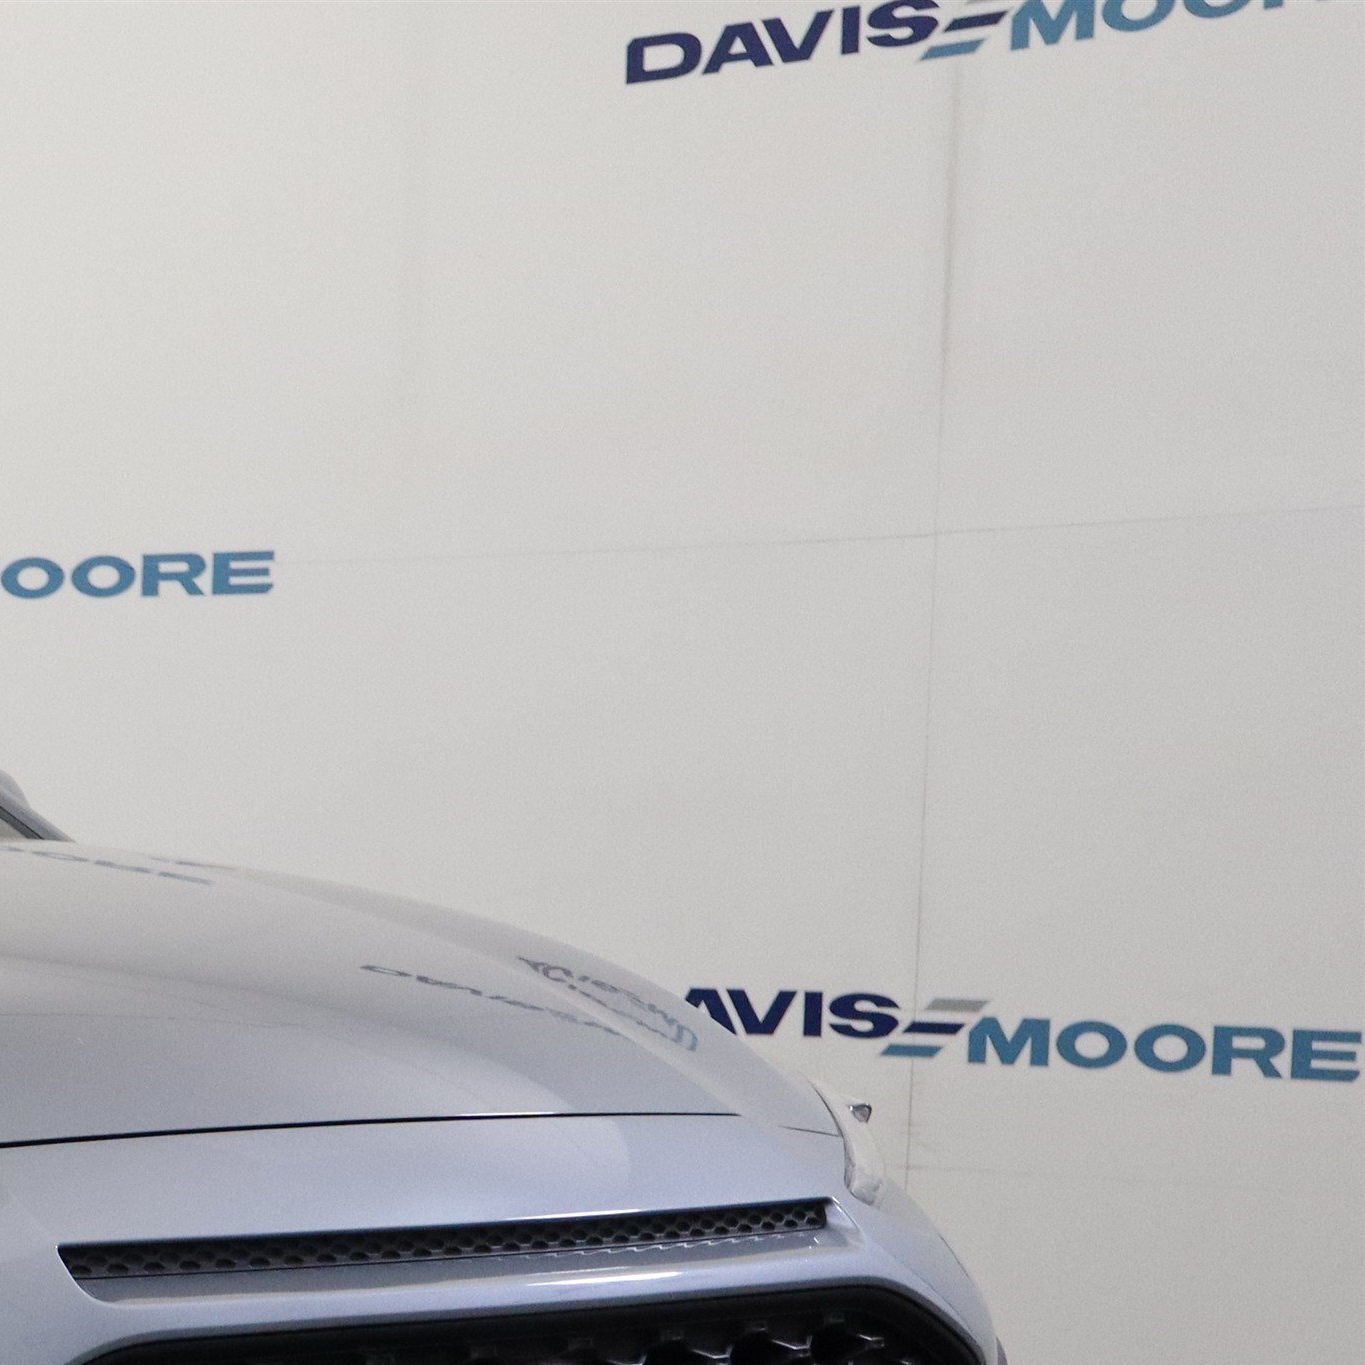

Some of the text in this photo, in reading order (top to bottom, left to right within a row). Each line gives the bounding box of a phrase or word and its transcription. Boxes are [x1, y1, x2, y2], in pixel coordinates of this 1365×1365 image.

[626, 1, 937, 84] DAVIS
[685, 987, 898, 1038] AVIS
[966, 1016, 1363, 1082] MOORE
